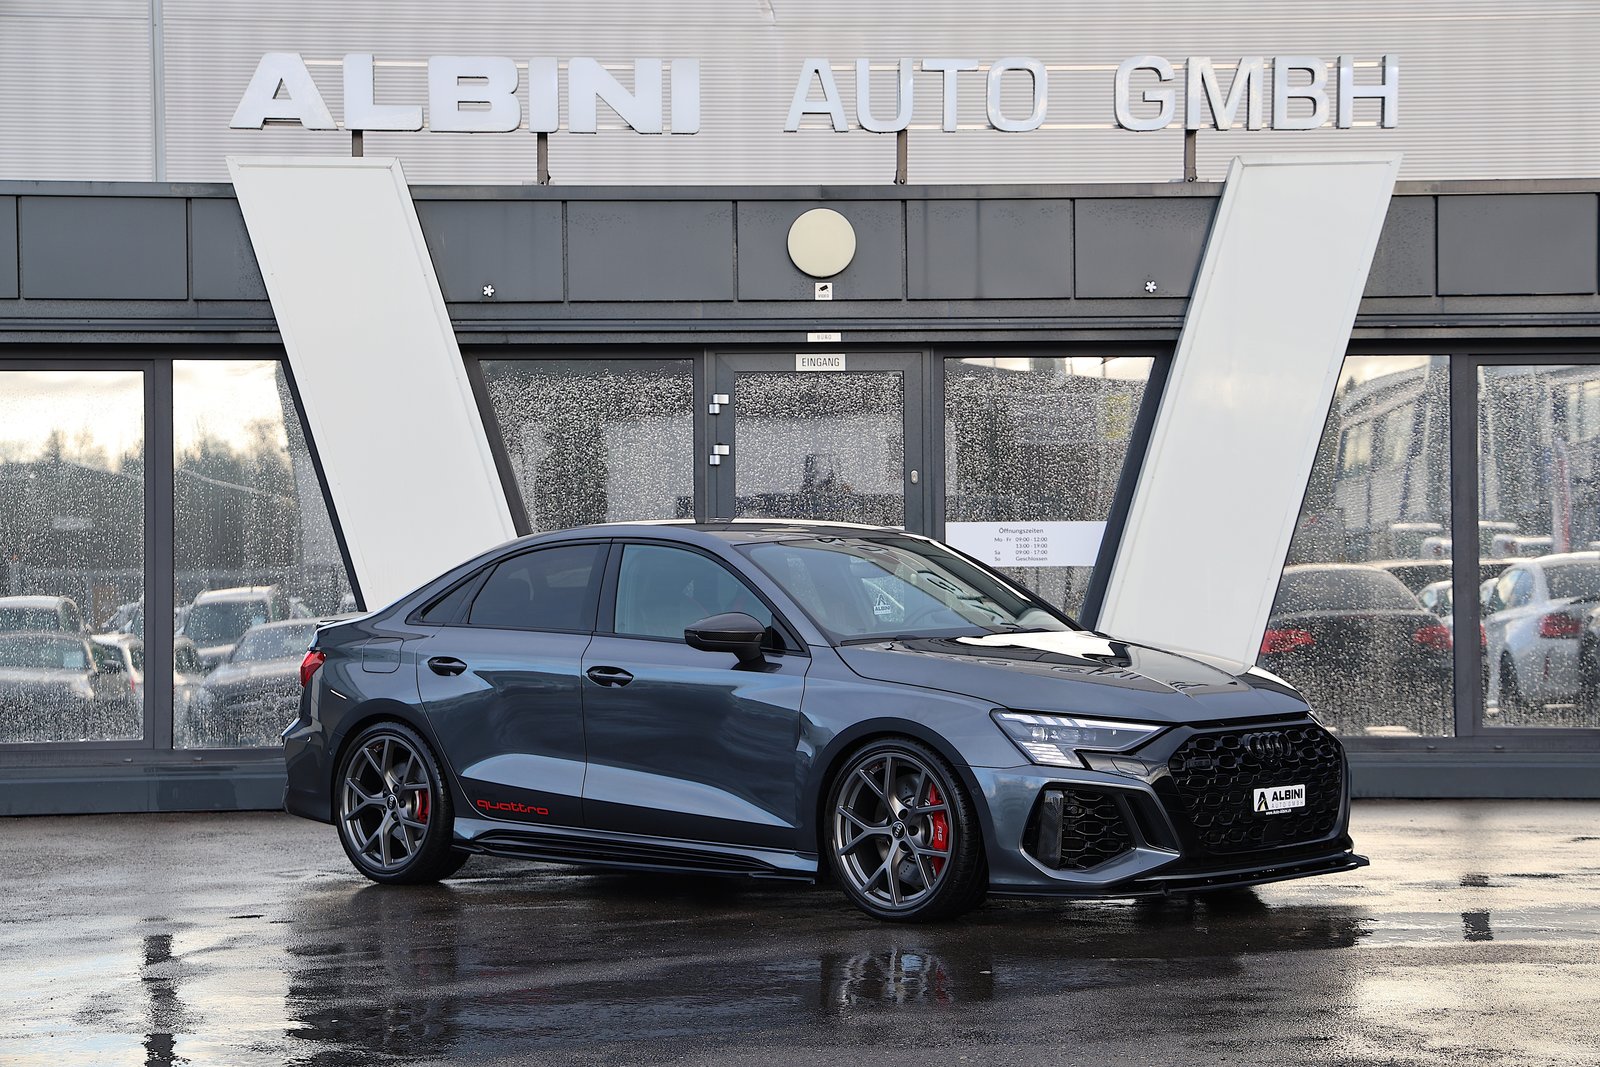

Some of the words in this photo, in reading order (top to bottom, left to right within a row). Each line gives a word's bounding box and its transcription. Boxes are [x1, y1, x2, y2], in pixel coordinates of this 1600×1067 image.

[229, 52, 700, 134] ALBINI
[784, 56, 1048, 133] AUTO
[1114, 55, 1400, 132] GMBH
[801, 357, 840, 367] EINGANG
[1272, 788, 1303, 801] ALBINI
[476, 799, 549, 815] quattro
[937, 825, 943, 842] RS
